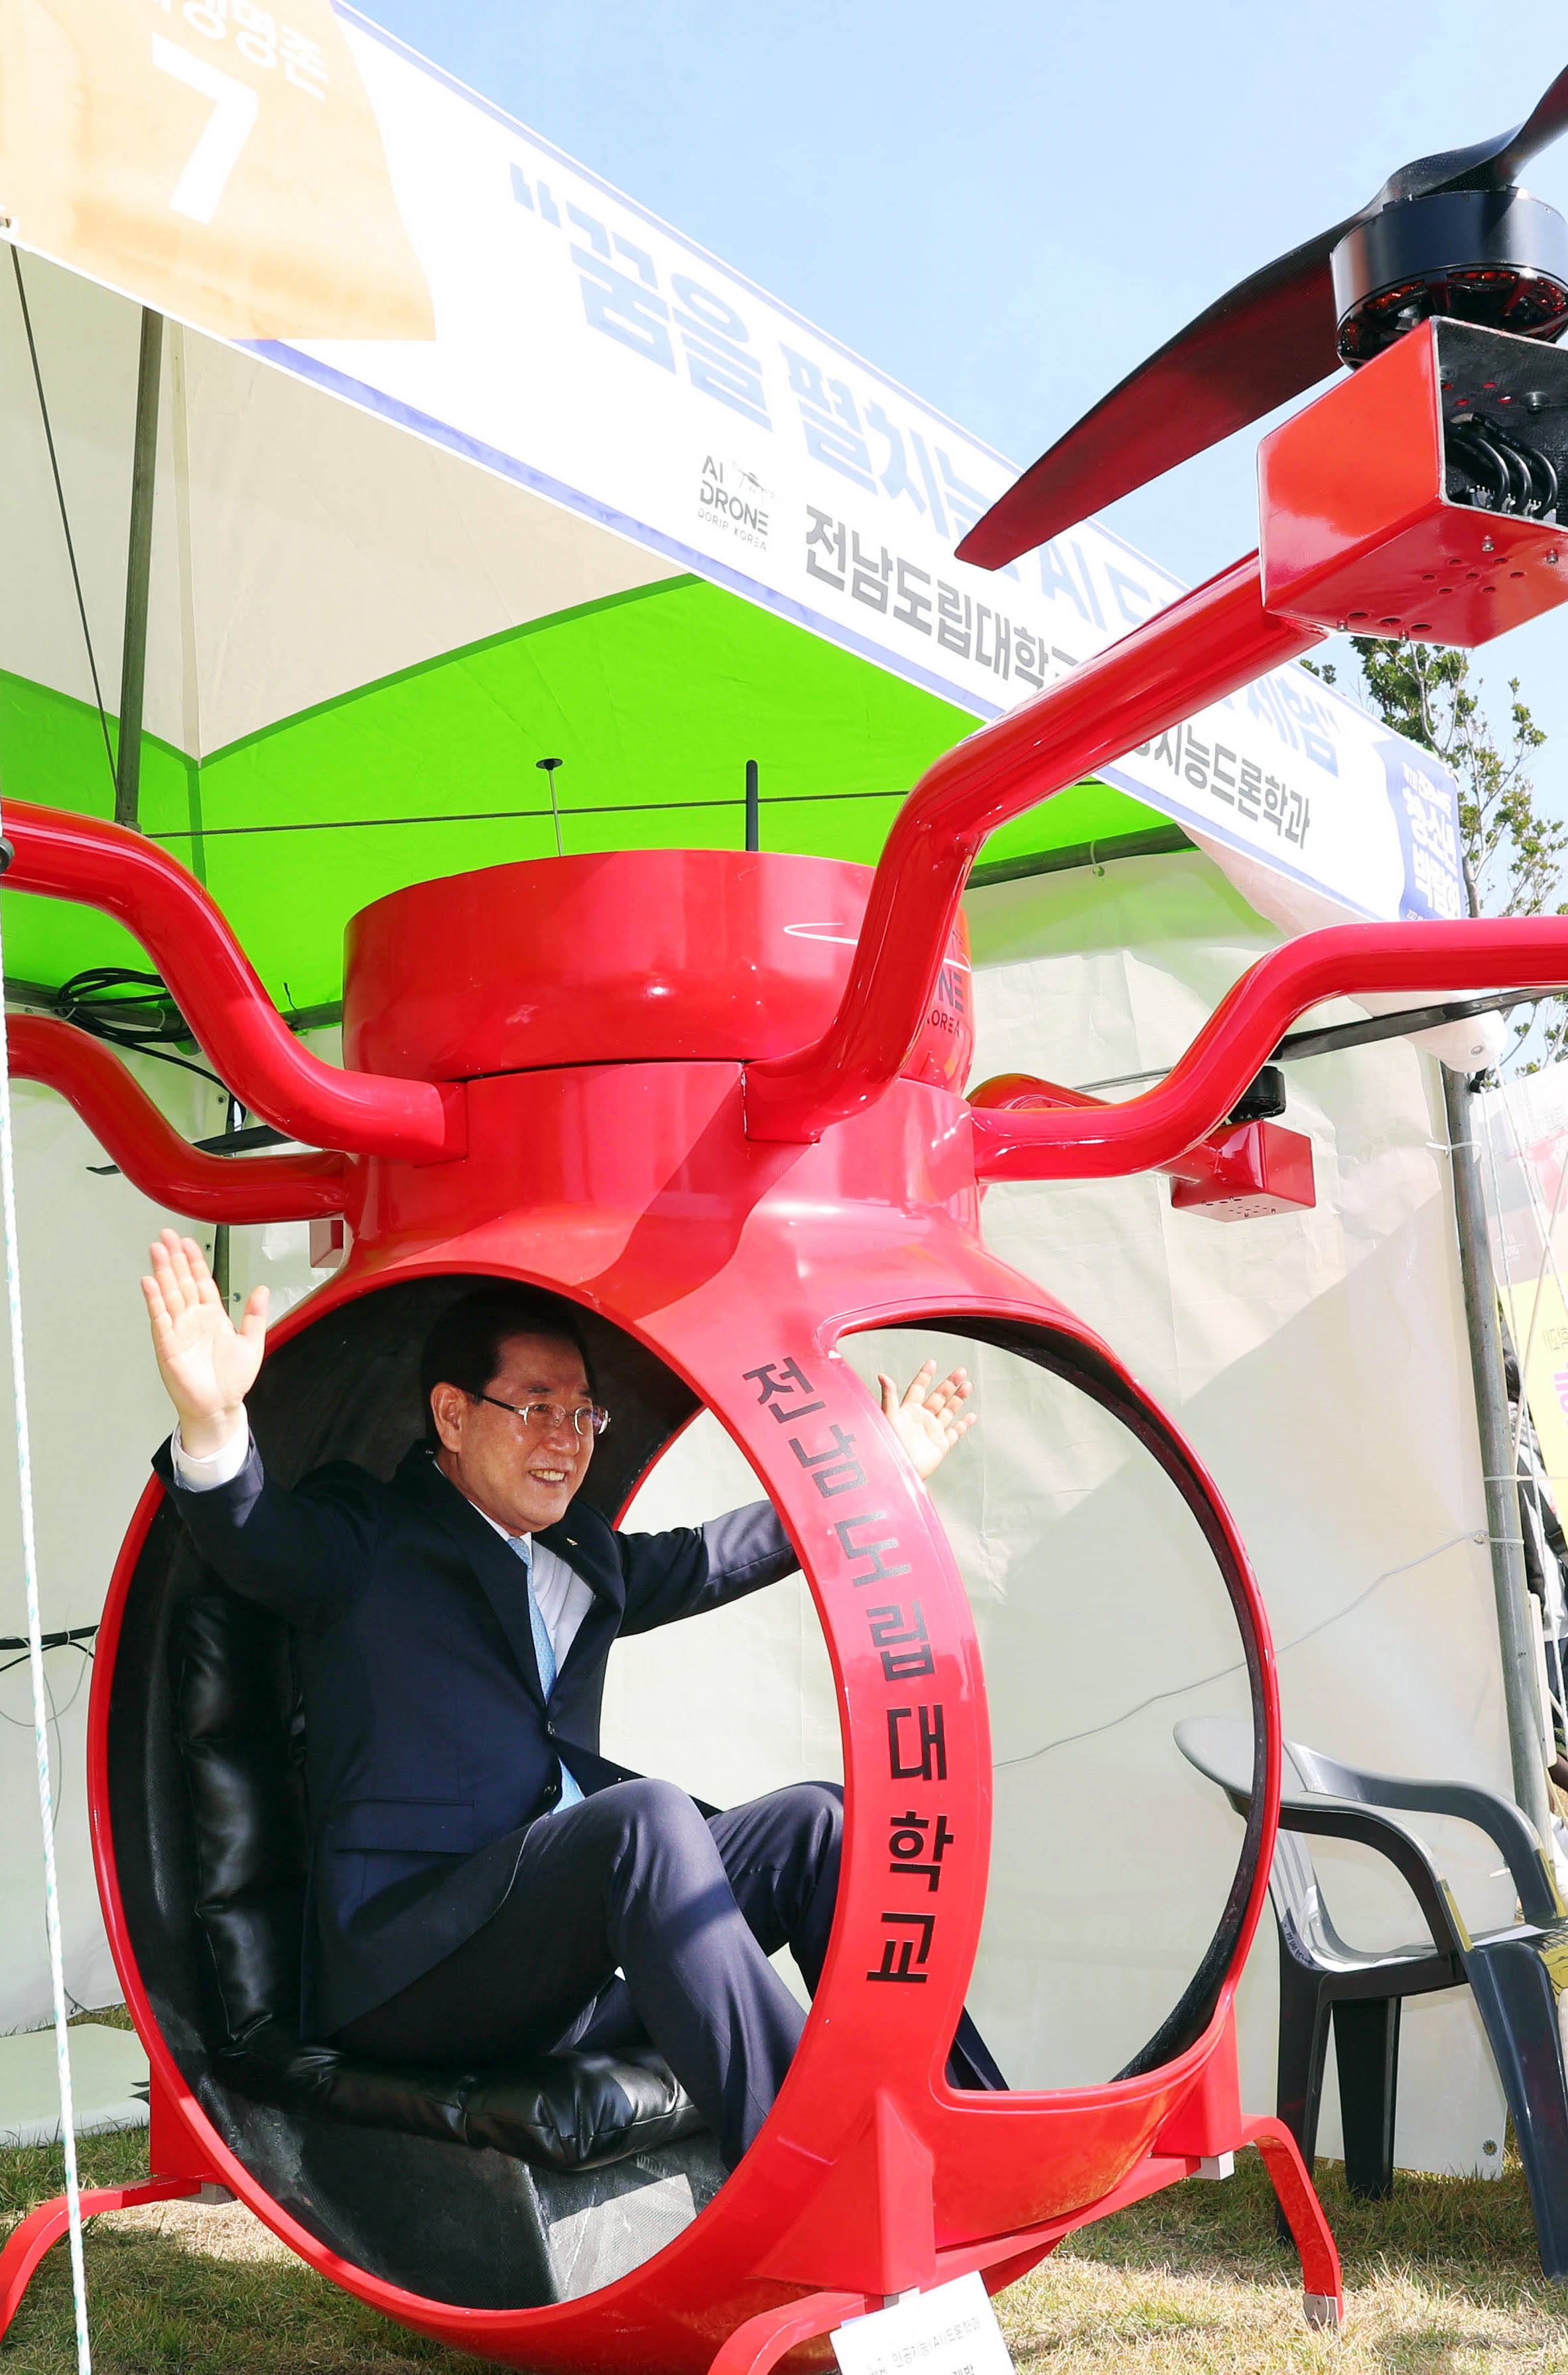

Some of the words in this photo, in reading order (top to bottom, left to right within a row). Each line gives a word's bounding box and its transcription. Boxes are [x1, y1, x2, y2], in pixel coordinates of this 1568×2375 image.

[151, 32, 258, 226] 7
[700, 479, 769, 536] DRONE
[702, 456, 723, 483] AI
[698, 508, 728, 530] DORIP
[734, 527, 767, 552] KOREA
[1038, 537, 1107, 632] AI
[806, 504, 1079, 691] 전남도립대학
[1133, 722, 1311, 850] 지능드론학과
[927, 1010, 960, 1037] OREA
[742, 1358, 953, 1984] 전남도립대학교
